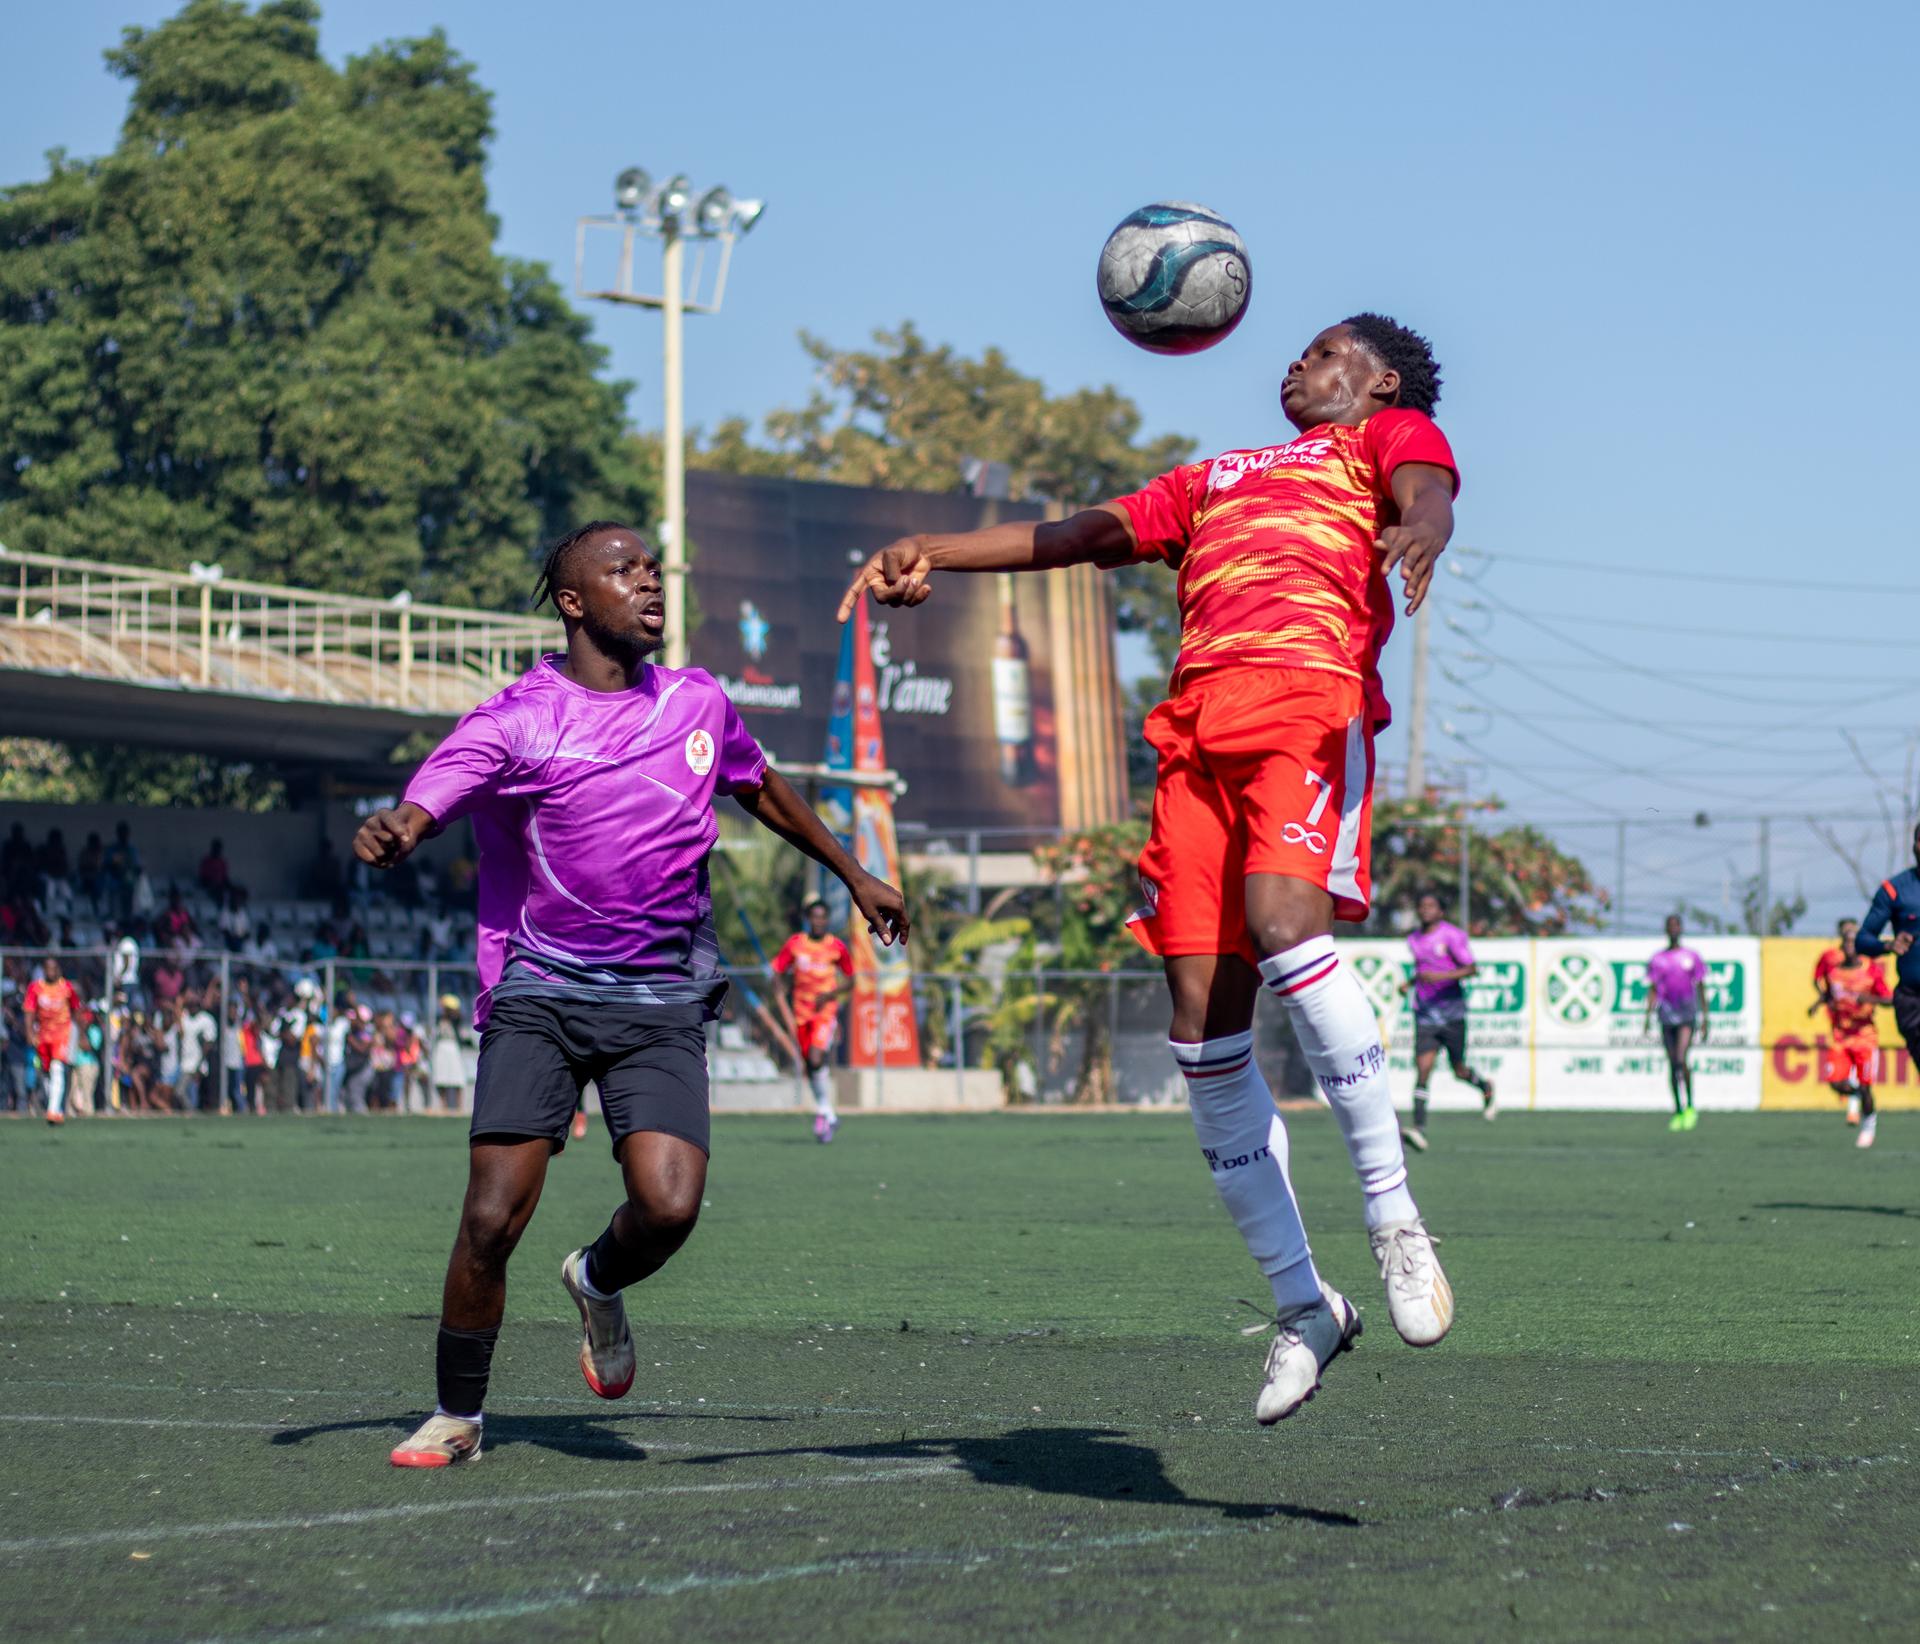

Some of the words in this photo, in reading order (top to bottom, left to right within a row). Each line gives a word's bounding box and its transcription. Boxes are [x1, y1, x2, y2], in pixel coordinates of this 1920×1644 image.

[1299, 453, 1323, 465] bar
[1304, 769, 1332, 827] 7
[1222, 1154, 1249, 1170] DO
[1253, 1145, 1270, 1162] IT
